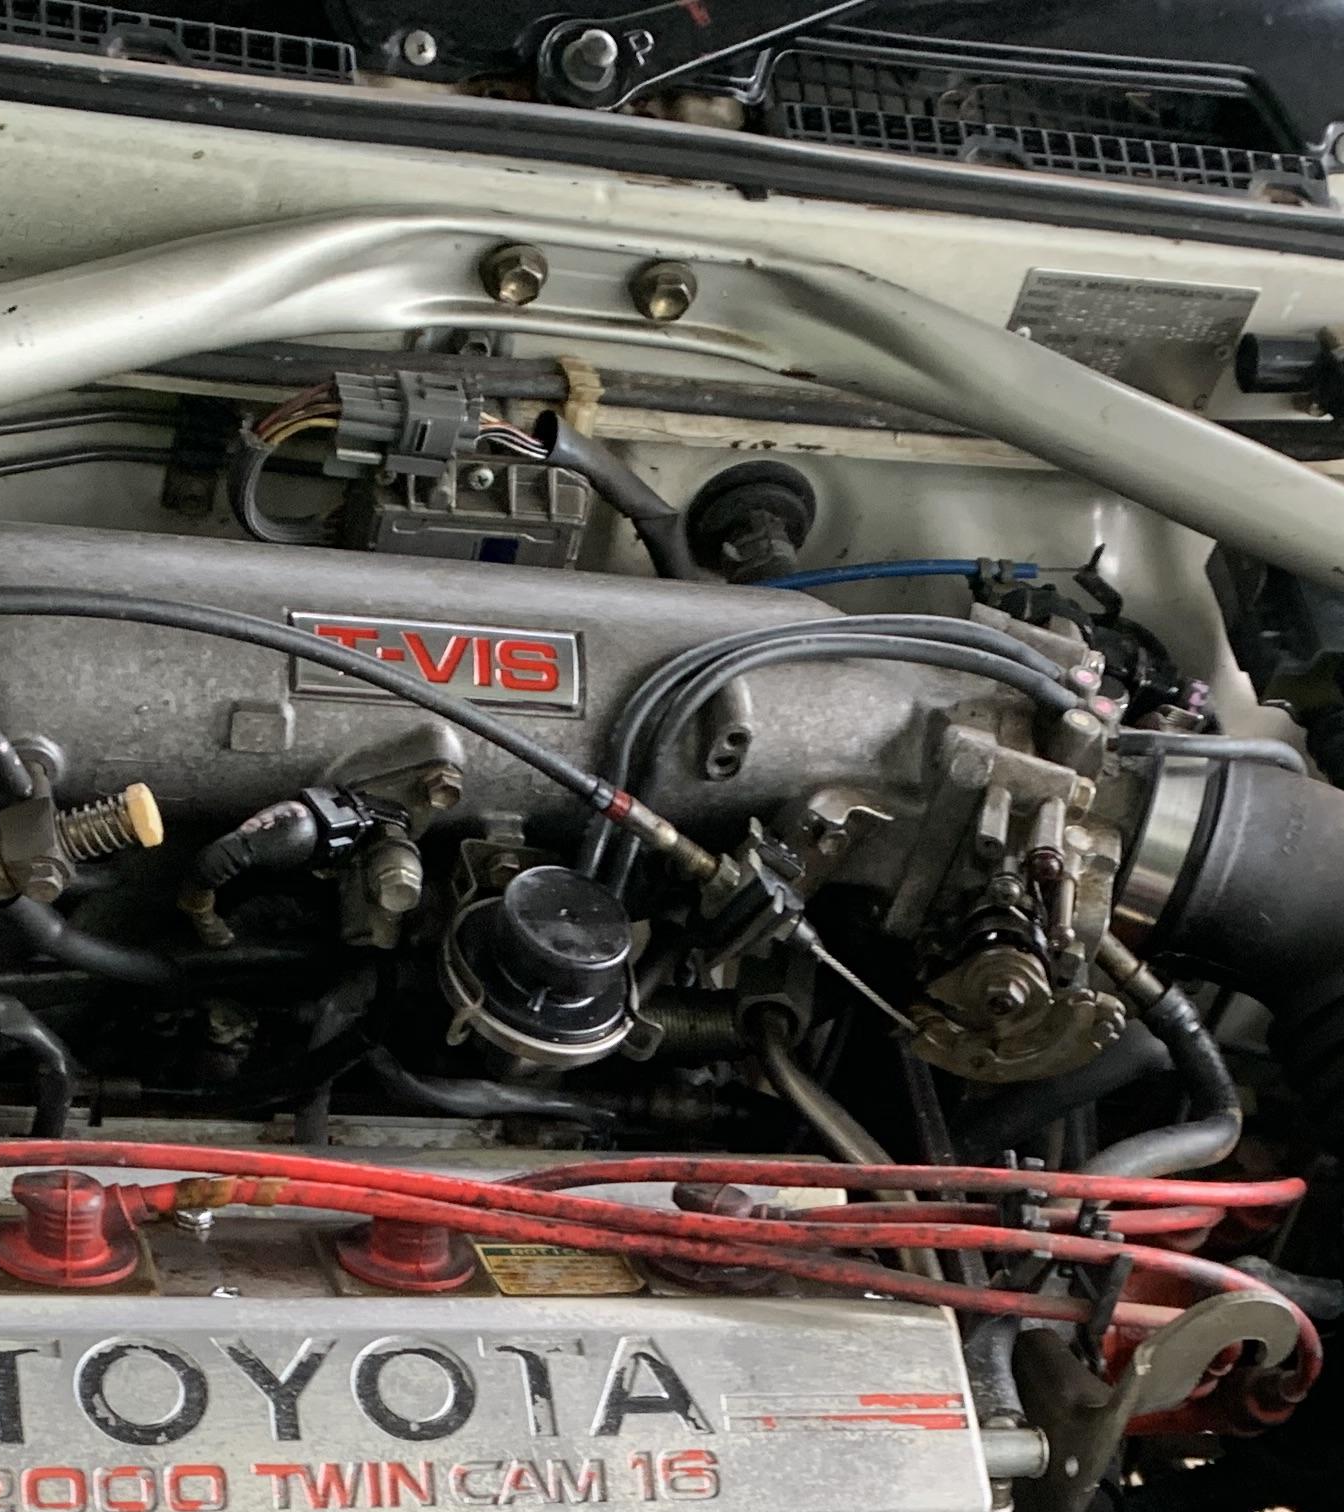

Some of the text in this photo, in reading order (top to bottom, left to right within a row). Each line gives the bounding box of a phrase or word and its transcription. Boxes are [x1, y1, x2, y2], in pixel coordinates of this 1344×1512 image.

[315, 624, 560, 692] T-VIS
[250, 1459, 436, 1511] TWIN
[448, 1456, 608, 1506] CAM
[628, 1449, 721, 1501] 16
